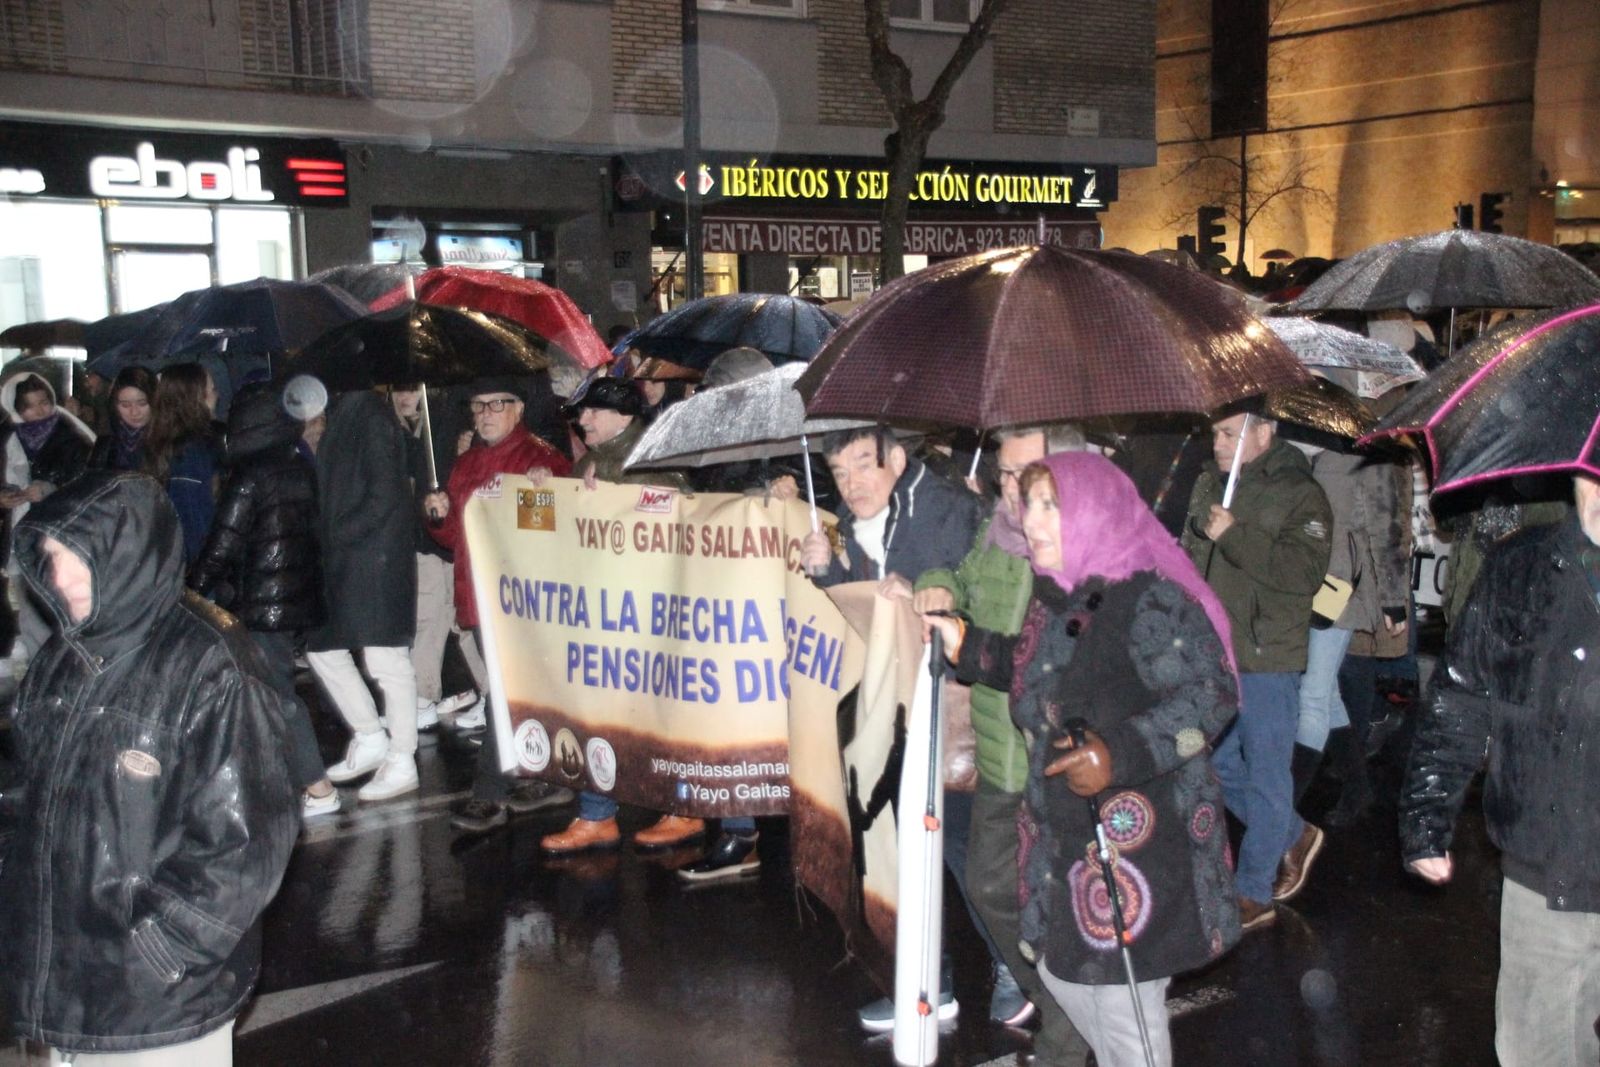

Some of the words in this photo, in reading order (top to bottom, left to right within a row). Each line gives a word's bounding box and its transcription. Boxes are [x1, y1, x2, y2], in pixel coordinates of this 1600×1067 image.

[89, 141, 275, 201] eboli
[722, 160, 829, 199] IBÉRICOS
[835, 170, 851, 199] Y
[975, 174, 1073, 203] GOURMET
[768, 225, 851, 252] DIRECTA
[857, 227, 882, 252] DE
[575, 517, 625, 555] YAY@
[633, 521, 695, 556] GAITAS
[499, 574, 591, 628] CONTRA
[600, 588, 640, 633] LA
[650, 592, 768, 644] BRECHA
[567, 641, 721, 704] PENSIONES
[690, 784, 729, 804] Yayo
[735, 783, 790, 799] Gaitas
